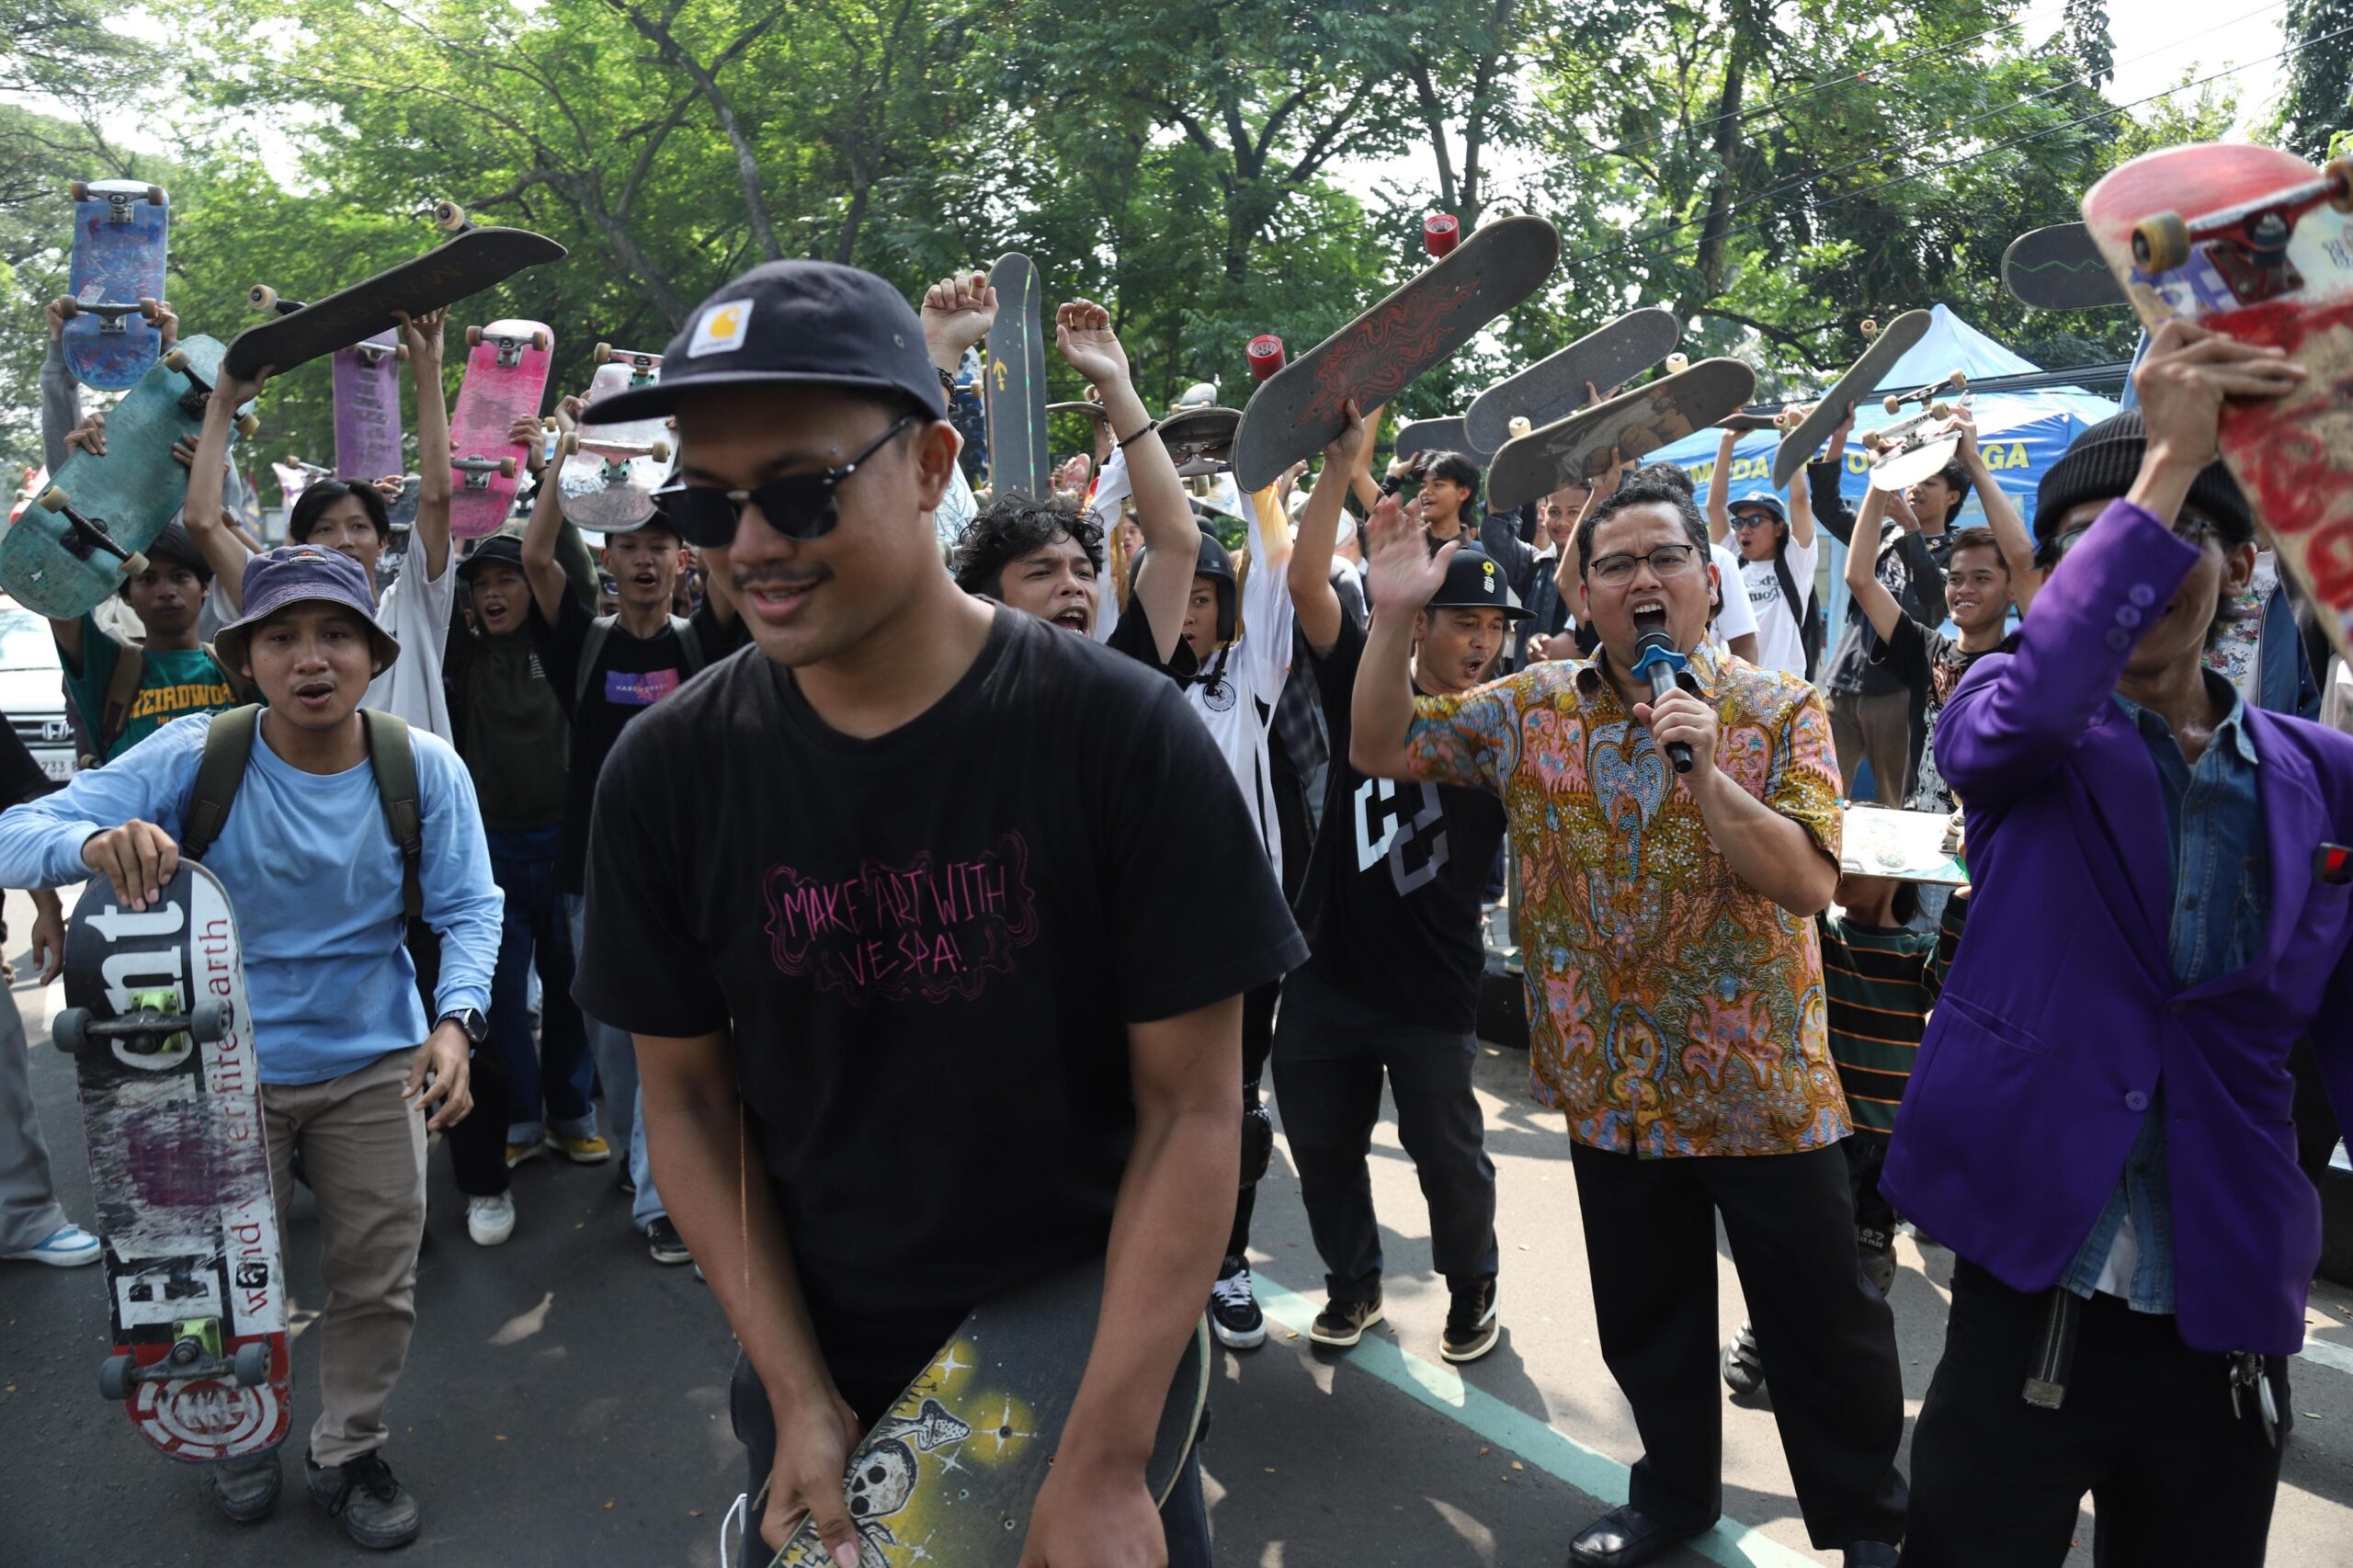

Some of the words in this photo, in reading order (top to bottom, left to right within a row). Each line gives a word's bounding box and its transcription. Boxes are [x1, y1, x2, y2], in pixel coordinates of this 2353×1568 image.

[784, 879, 862, 941] MAKE
[874, 870, 923, 930] ART
[928, 861, 1007, 926] WITH
[838, 929, 968, 985] VESPA!
